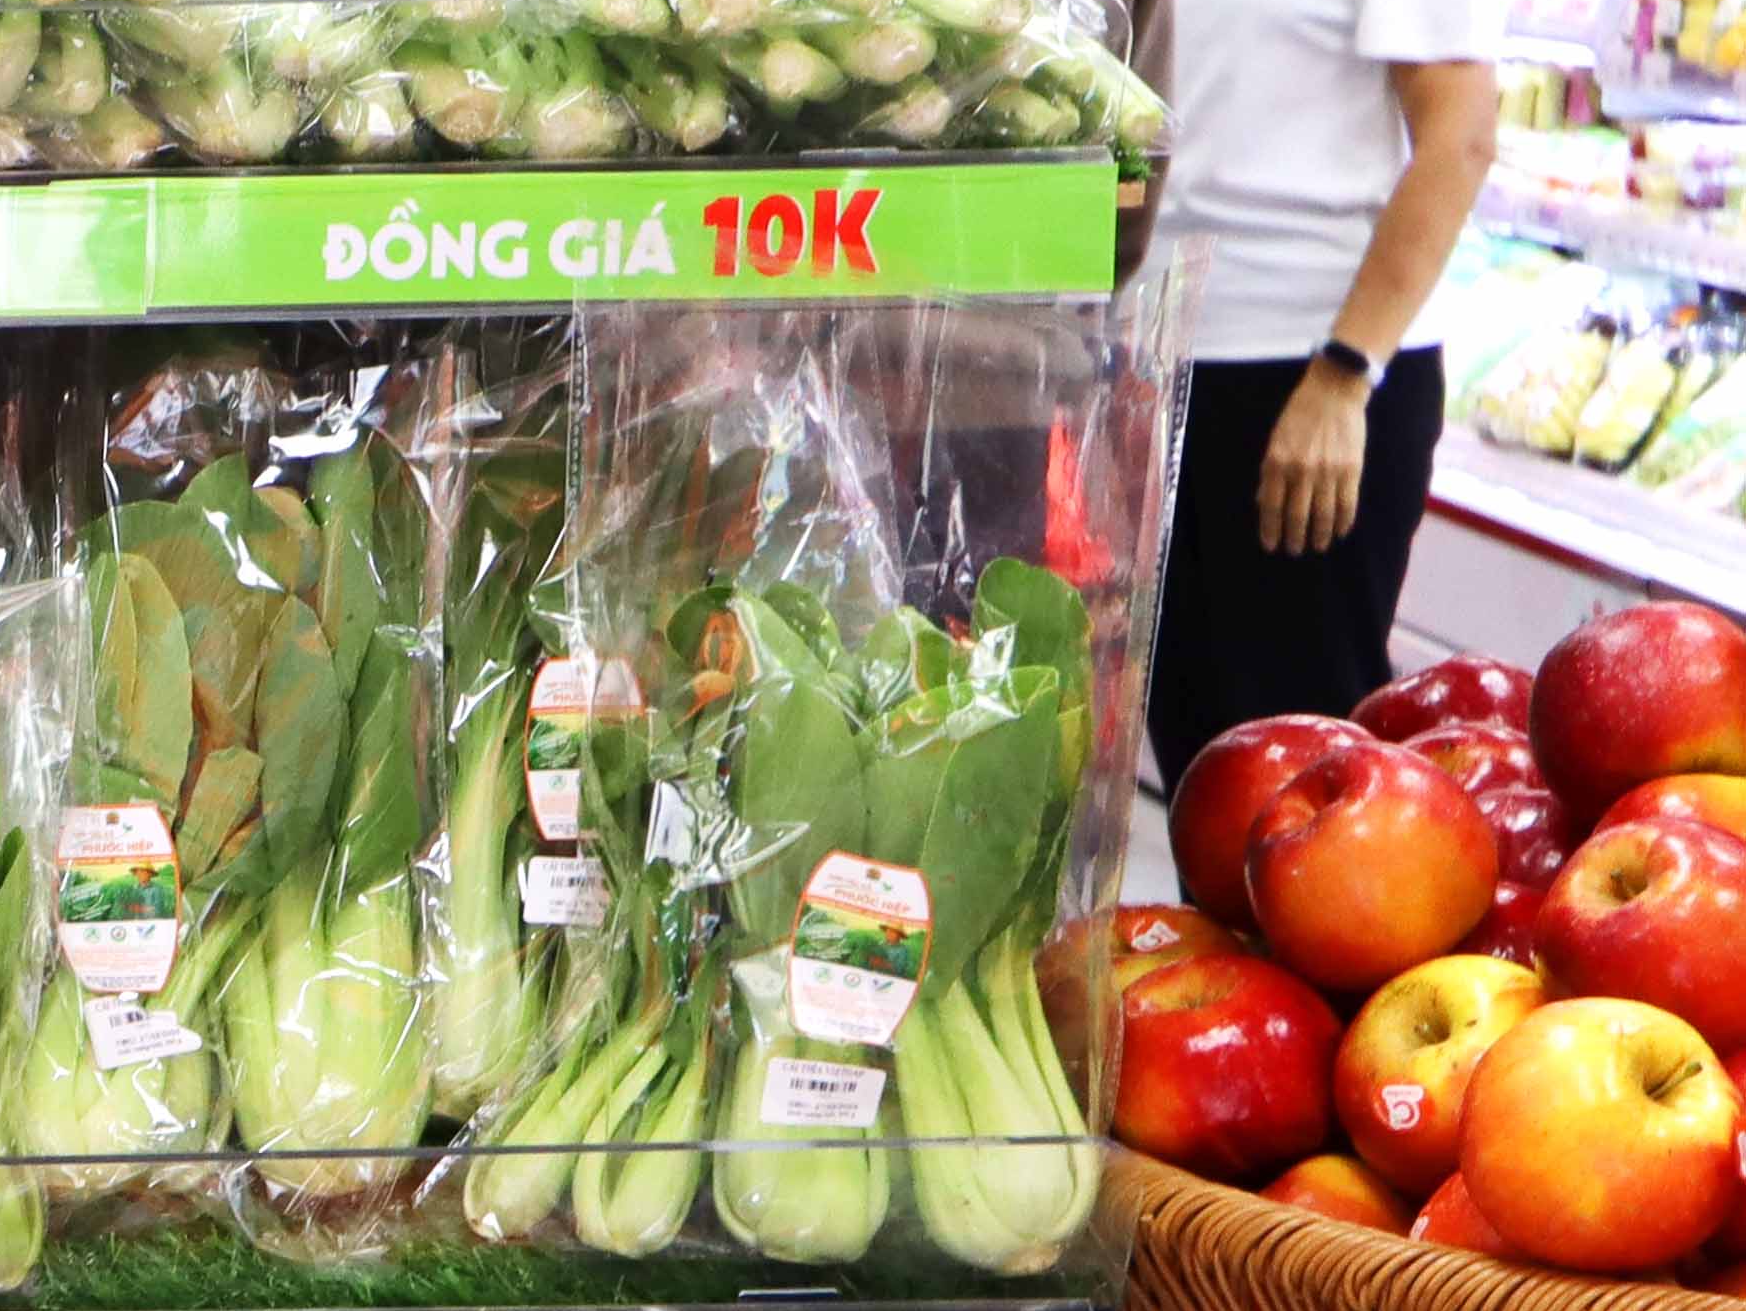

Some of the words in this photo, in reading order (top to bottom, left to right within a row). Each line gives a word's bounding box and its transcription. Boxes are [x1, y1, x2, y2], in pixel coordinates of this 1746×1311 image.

[323, 198, 528, 281] ĐỒNG
[548, 203, 676, 279] GIÁ
[703, 188, 885, 277] 10K
